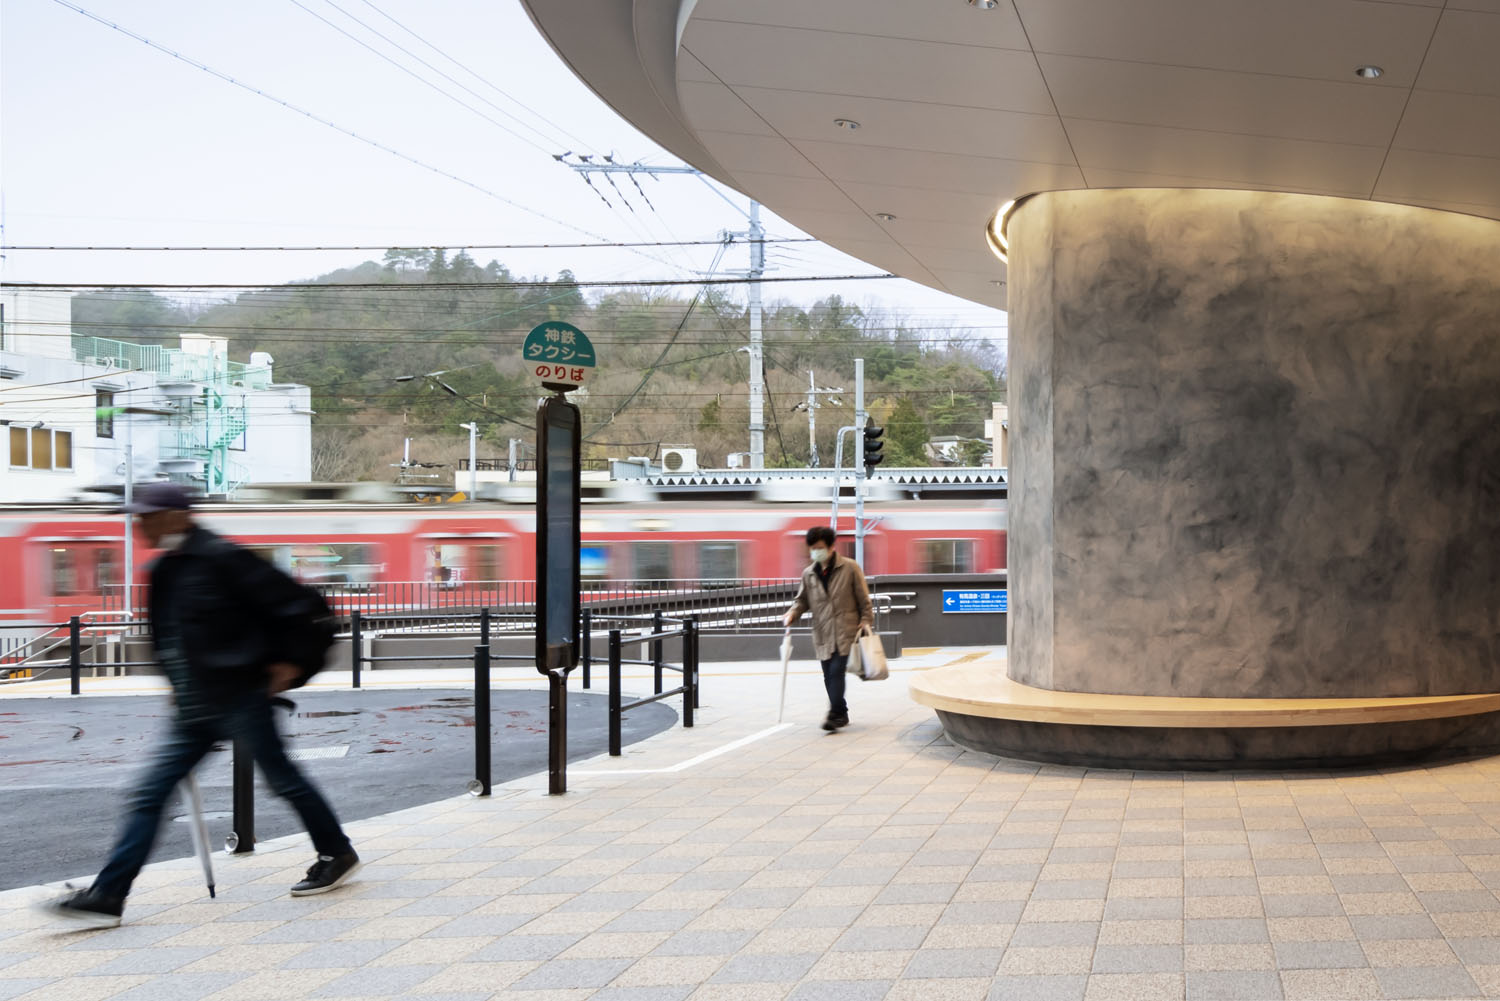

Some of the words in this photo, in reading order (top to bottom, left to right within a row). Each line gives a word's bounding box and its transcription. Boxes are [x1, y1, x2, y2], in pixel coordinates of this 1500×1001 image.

[545, 328, 576, 345] 神鉄
[528, 343, 591, 360] タクシー
[536, 365, 584, 381] のりば
